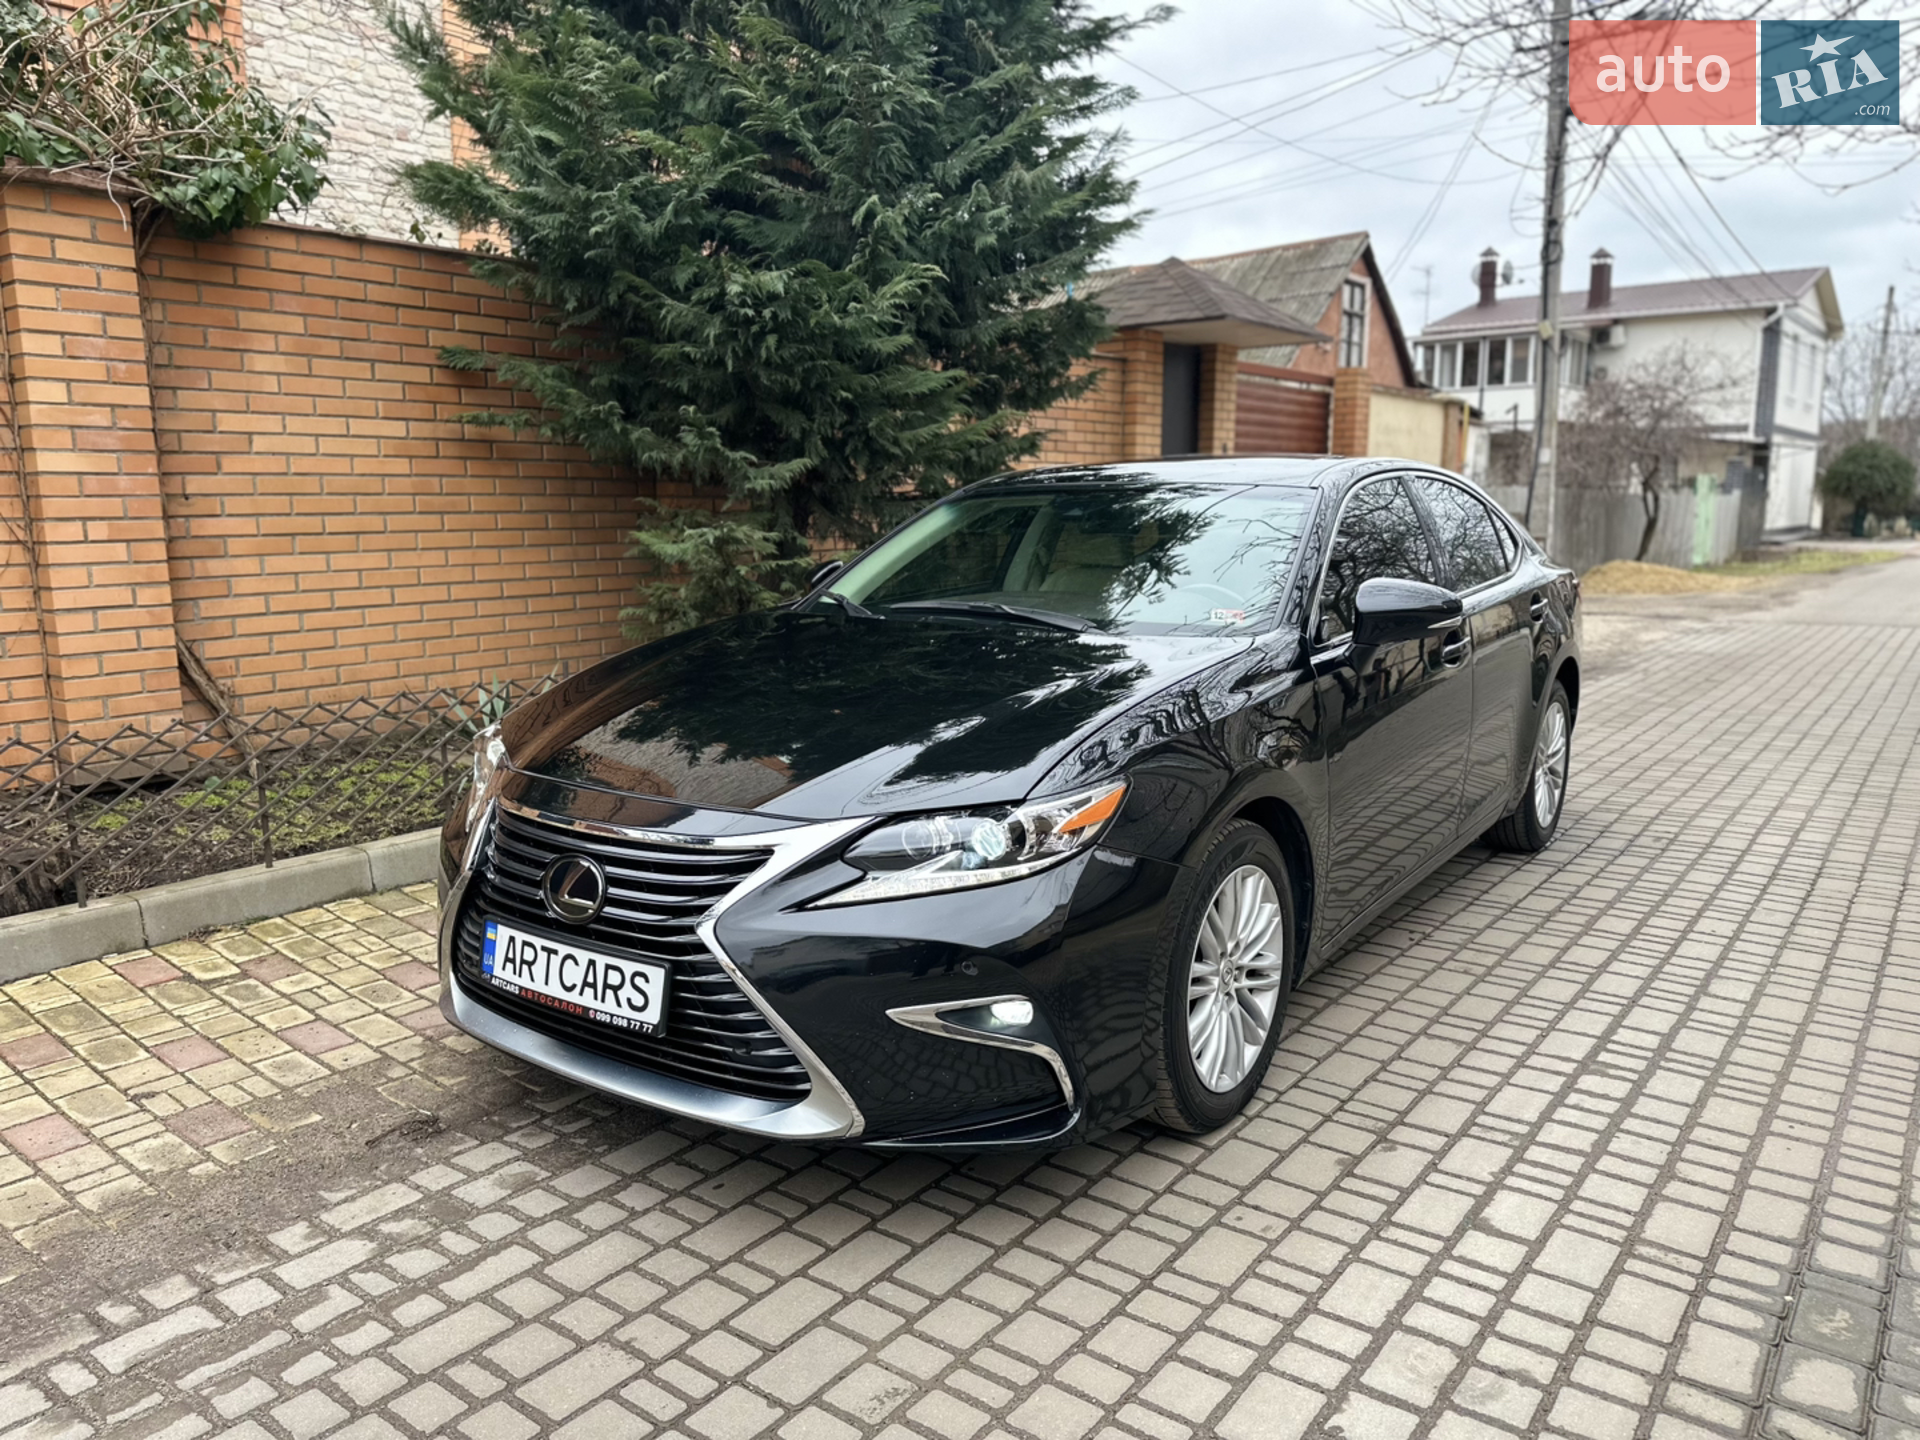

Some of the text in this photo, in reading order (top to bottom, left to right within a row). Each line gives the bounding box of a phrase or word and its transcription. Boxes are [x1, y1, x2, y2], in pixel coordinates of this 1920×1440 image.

[483, 953, 494, 966] UA
[501, 935, 650, 1013] ARTCARS
[490, 976, 520, 995] ARTCARS
[520, 988, 583, 1015] АВТОСАЛОН
[595, 1011, 611, 1023] 099
[629, 1020, 641, 1030] 77
[642, 1023, 653, 1033] 77
